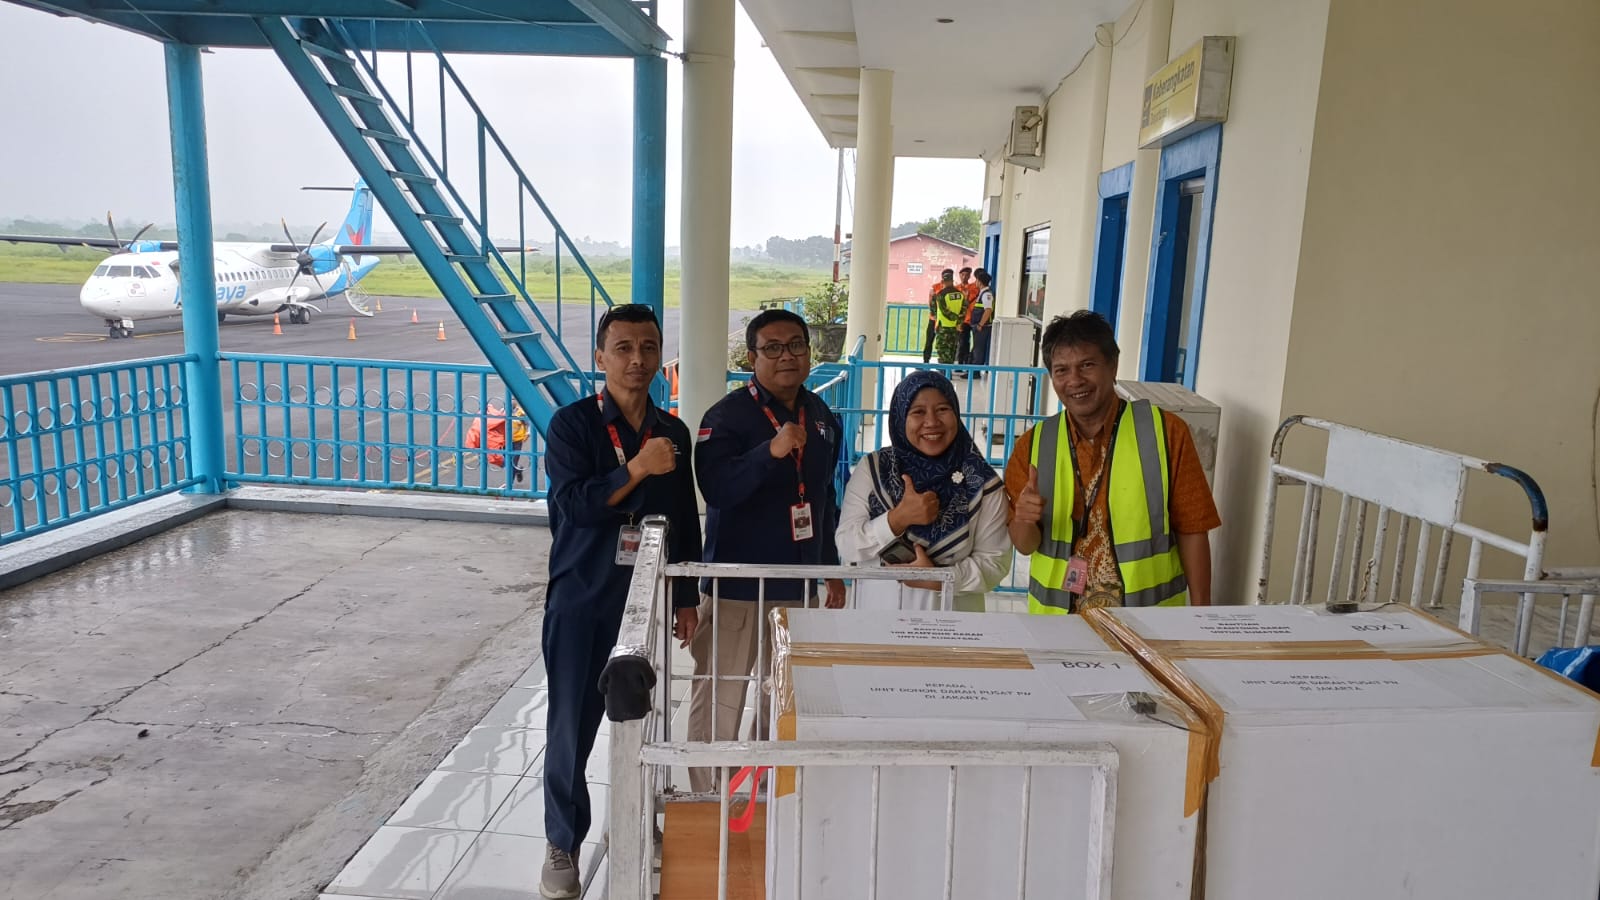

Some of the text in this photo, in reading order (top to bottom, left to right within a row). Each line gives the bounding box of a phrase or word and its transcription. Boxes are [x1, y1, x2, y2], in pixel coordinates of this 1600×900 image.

[1352, 622, 1410, 632] BOX 2
[1061, 661, 1121, 670] BOX 1
